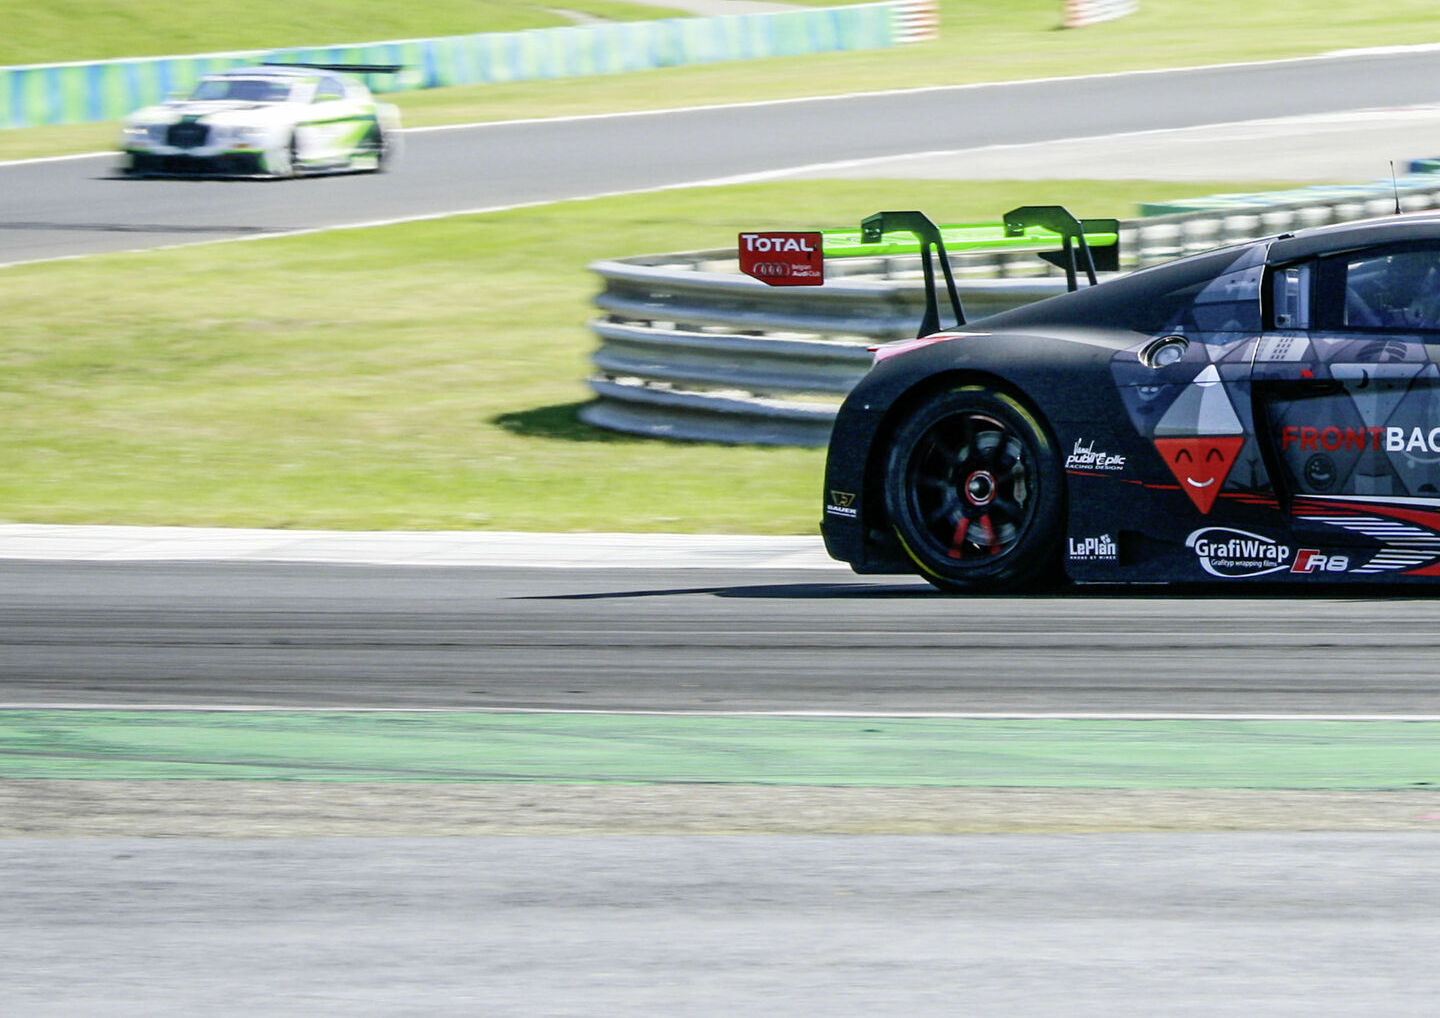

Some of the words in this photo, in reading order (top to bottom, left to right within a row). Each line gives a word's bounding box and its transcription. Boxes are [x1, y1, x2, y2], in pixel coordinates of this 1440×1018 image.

[741, 234, 814, 252] TOTAL
[1069, 537, 1116, 555] LePlan
[1195, 539, 1289, 563] GrafiWrap
[1235, 560, 1263, 568] wrapping
[1304, 554, 1349, 572] R8
